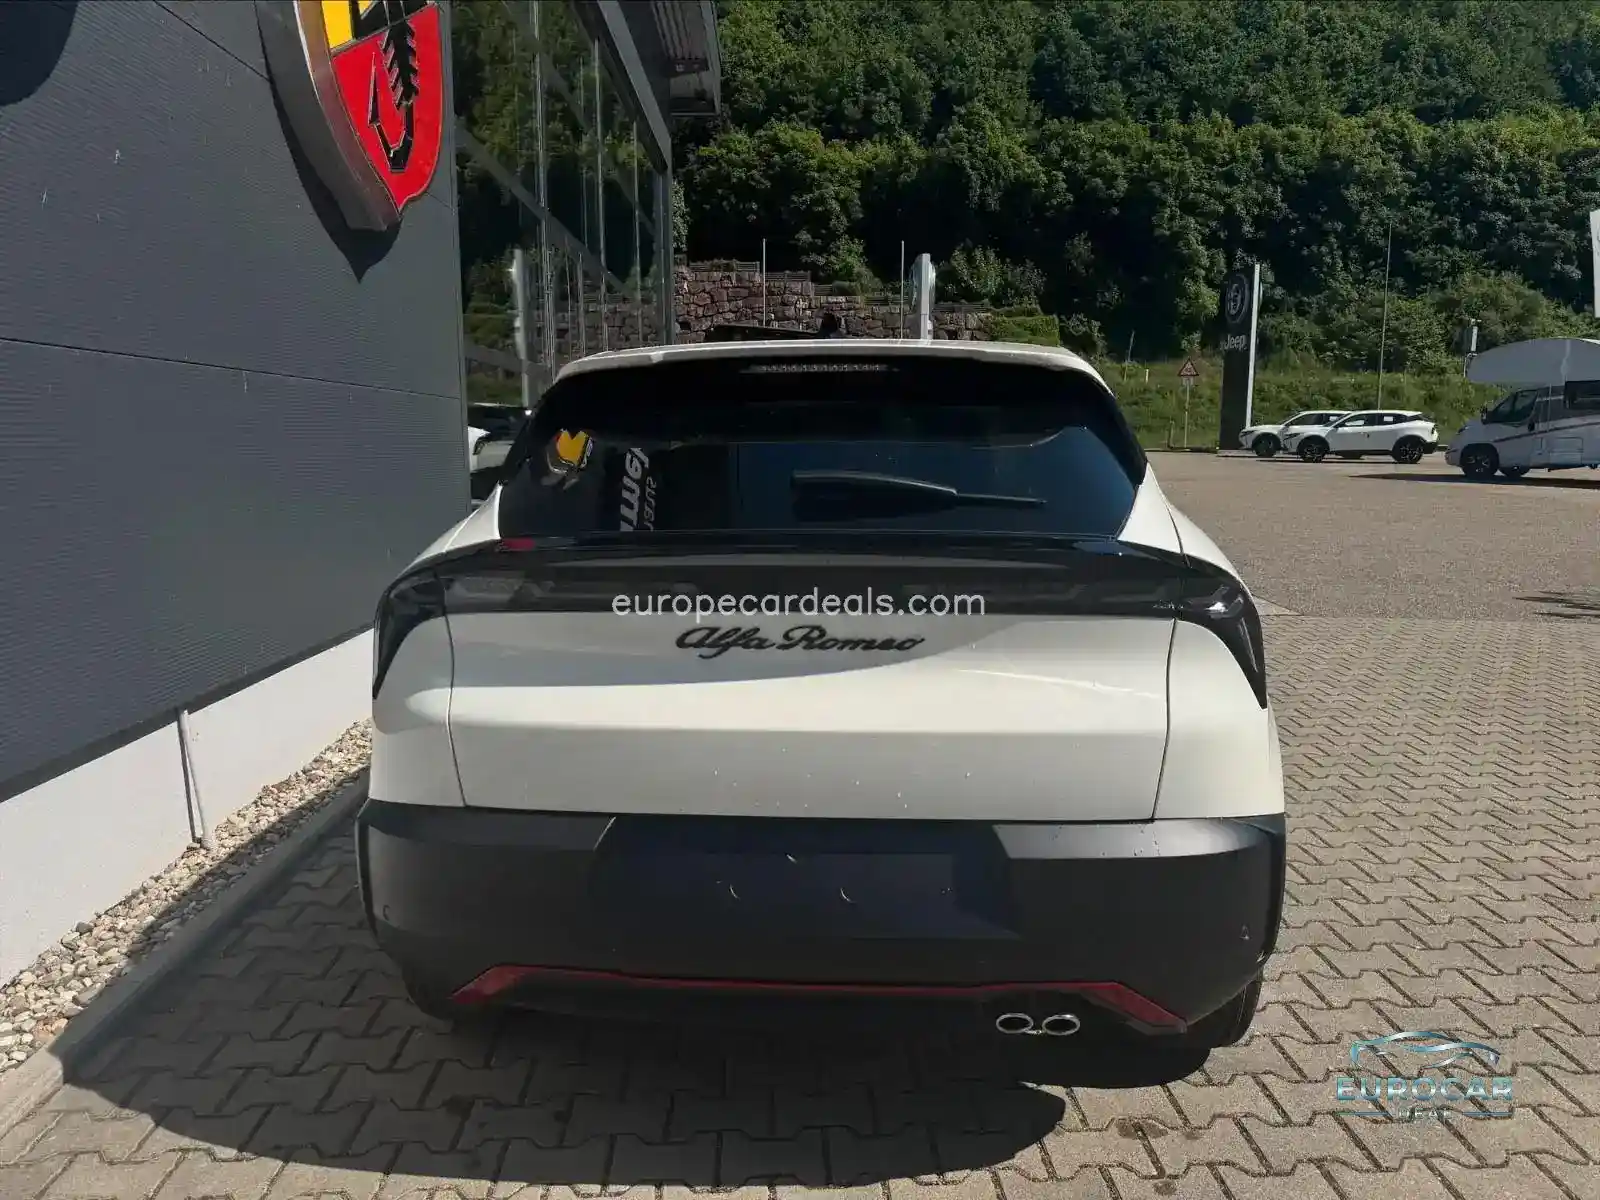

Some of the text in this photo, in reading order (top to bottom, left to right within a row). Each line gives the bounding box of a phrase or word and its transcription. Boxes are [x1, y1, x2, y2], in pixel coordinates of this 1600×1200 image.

[1224, 334, 1247, 352] Jeep
[675, 625, 925, 659] Alfa Romeo
